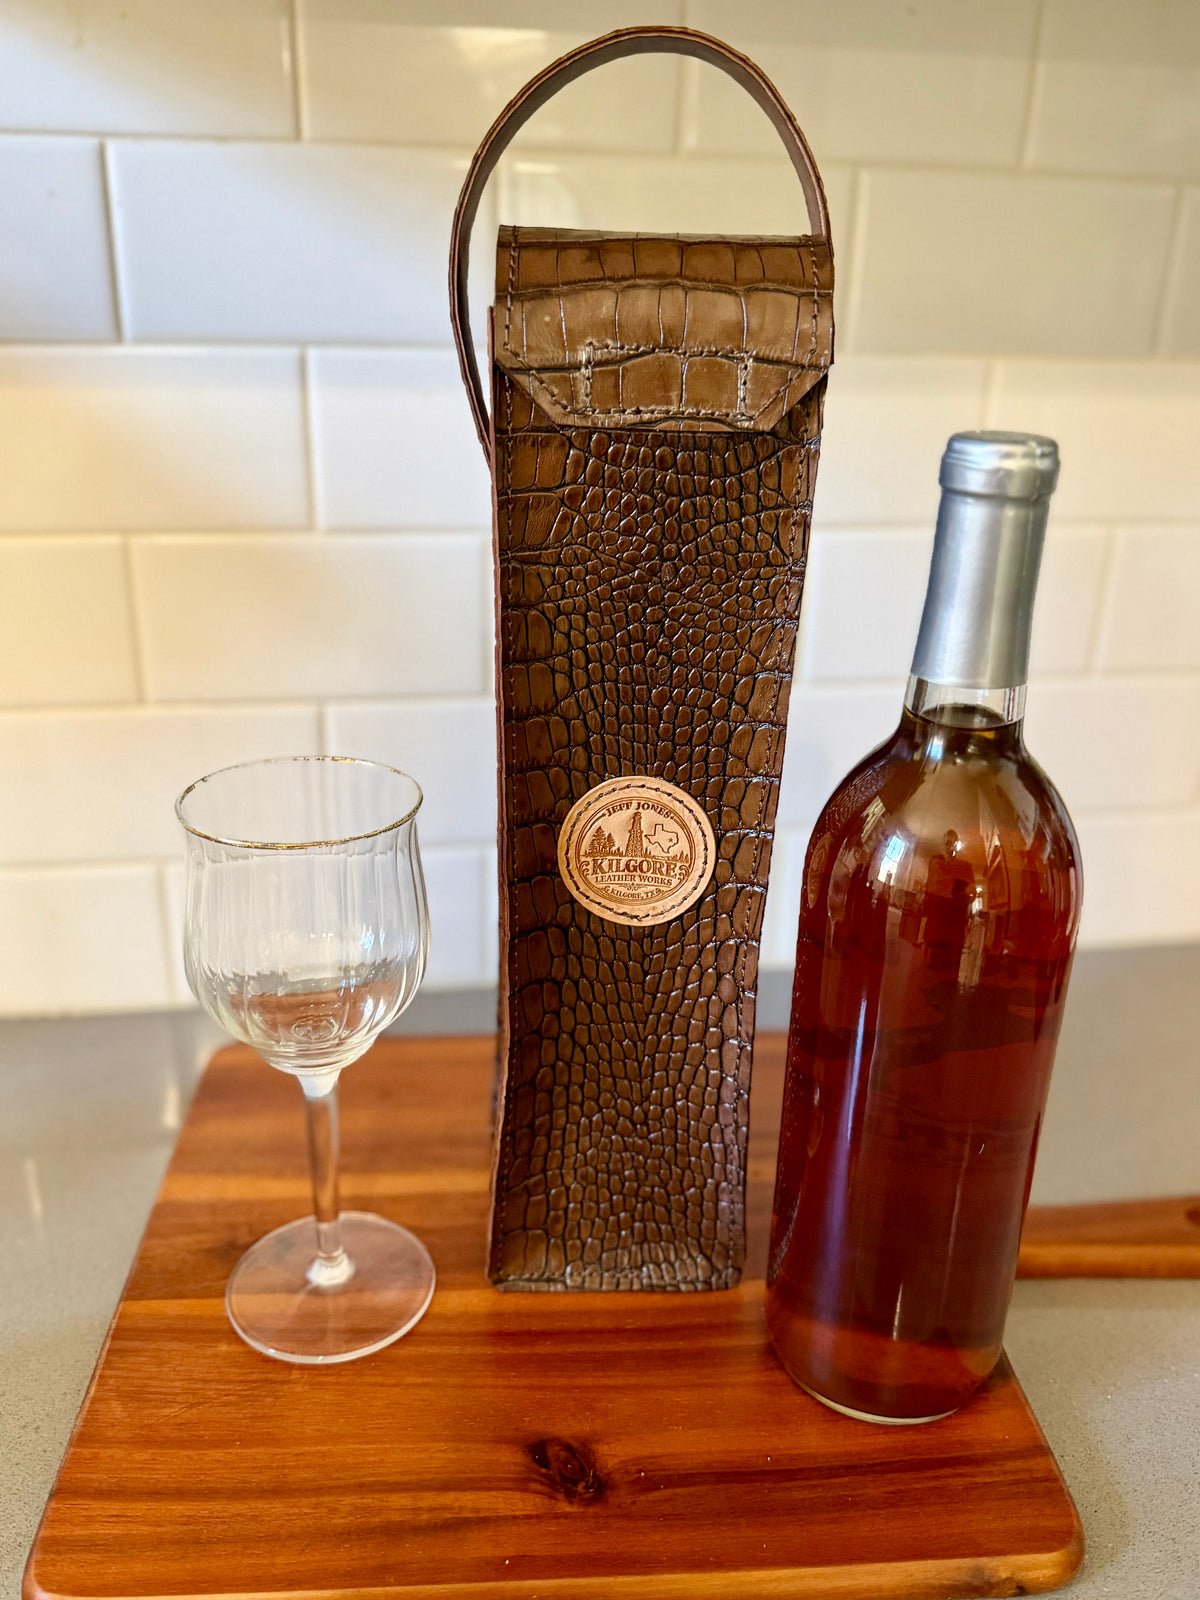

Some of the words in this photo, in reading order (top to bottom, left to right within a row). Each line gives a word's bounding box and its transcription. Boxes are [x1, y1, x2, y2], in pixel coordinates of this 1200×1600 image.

[606, 801, 633, 817] JEFF
[635, 801, 672, 819] JONES
[591, 858, 678, 879] KILGORE
[595, 874, 637, 883] LEATHER
[638, 875, 673, 886] WORKS
